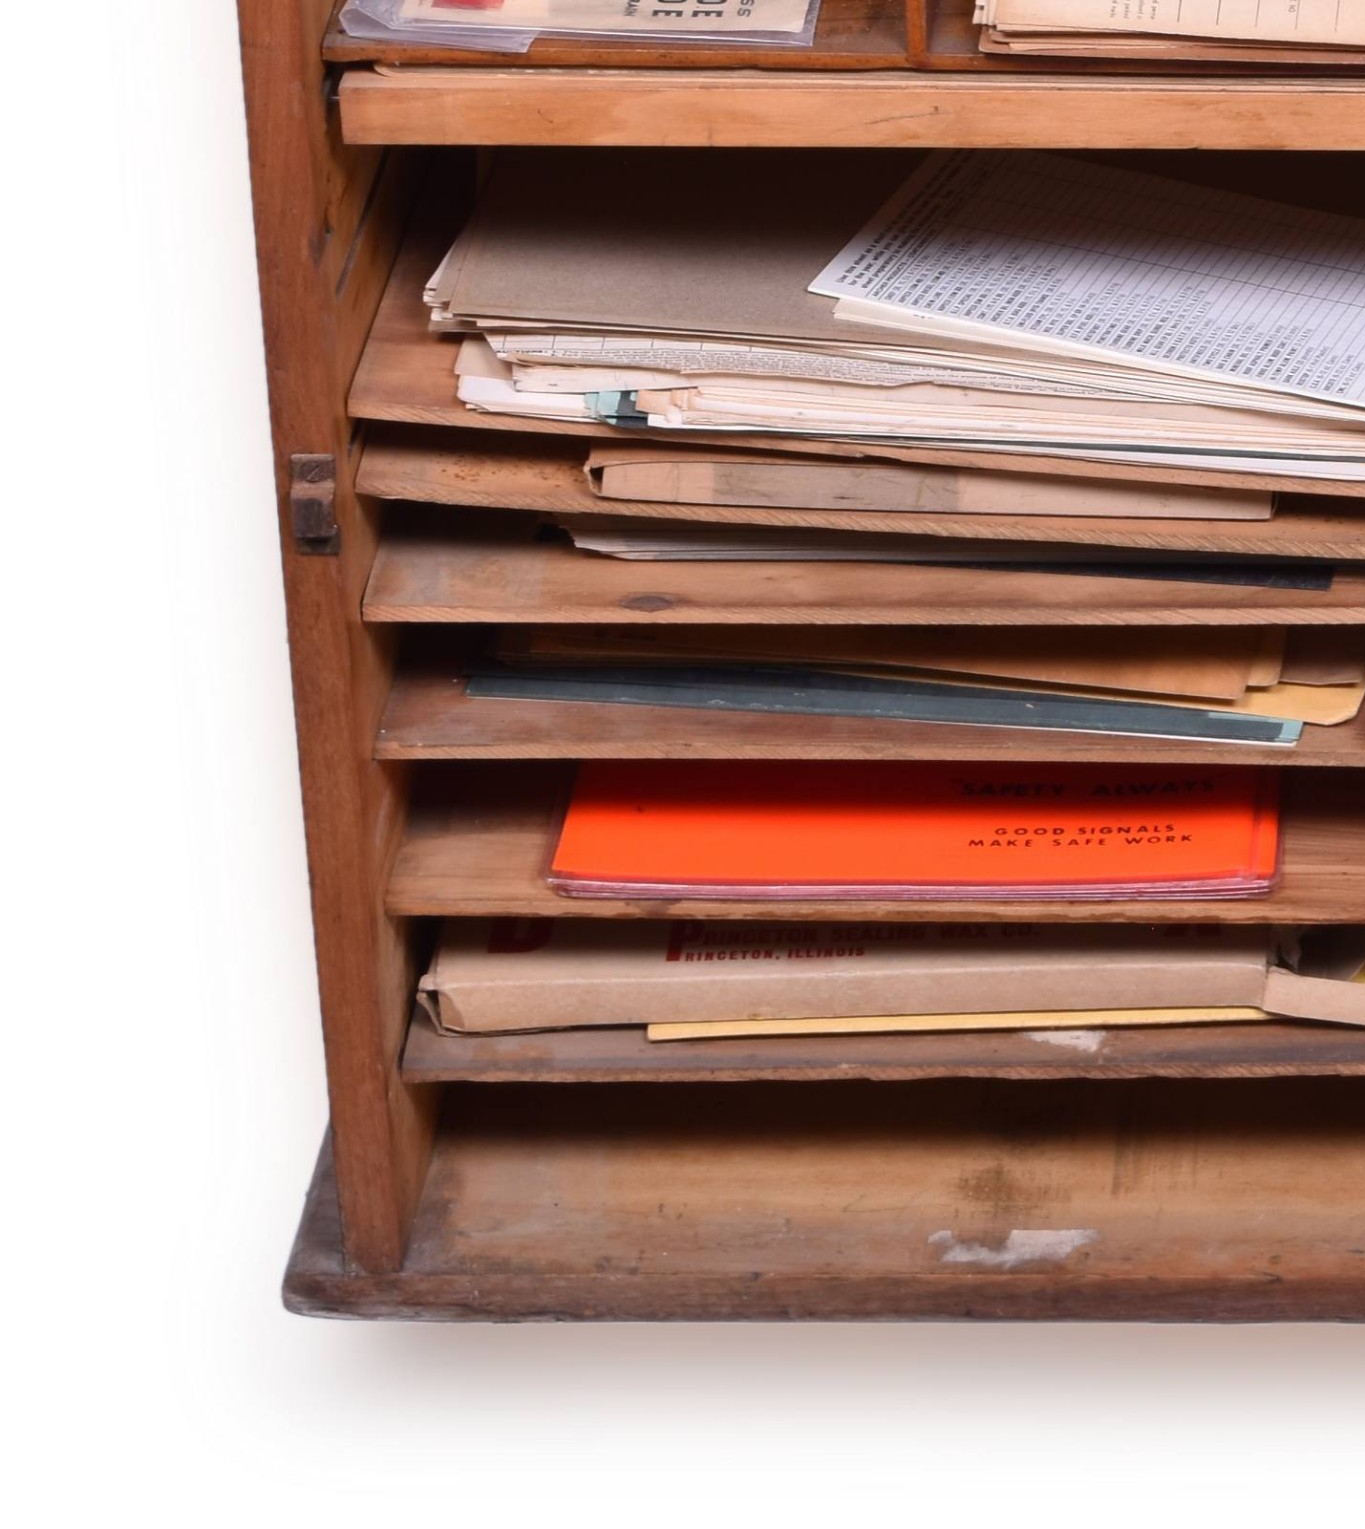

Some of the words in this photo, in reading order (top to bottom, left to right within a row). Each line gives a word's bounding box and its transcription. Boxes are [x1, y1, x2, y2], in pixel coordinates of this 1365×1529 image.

[887, 262, 905, 281] PRODUCTS
[960, 782, 1067, 797] SAFETY
[1090, 778, 1216, 797] ALWAYS
[994, 826, 1066, 837] GOOD
[1077, 824, 1176, 836] SIGNALS
[967, 838, 1034, 848] MAKE
[1051, 837, 1107, 847] SAFE
[1124, 833, 1194, 846] WORK
[828, 925, 928, 945] SEALING
[939, 924, 992, 942] WAX
[1002, 922, 1042, 941] CO.
[788, 945, 867, 962] ILLINOIS
